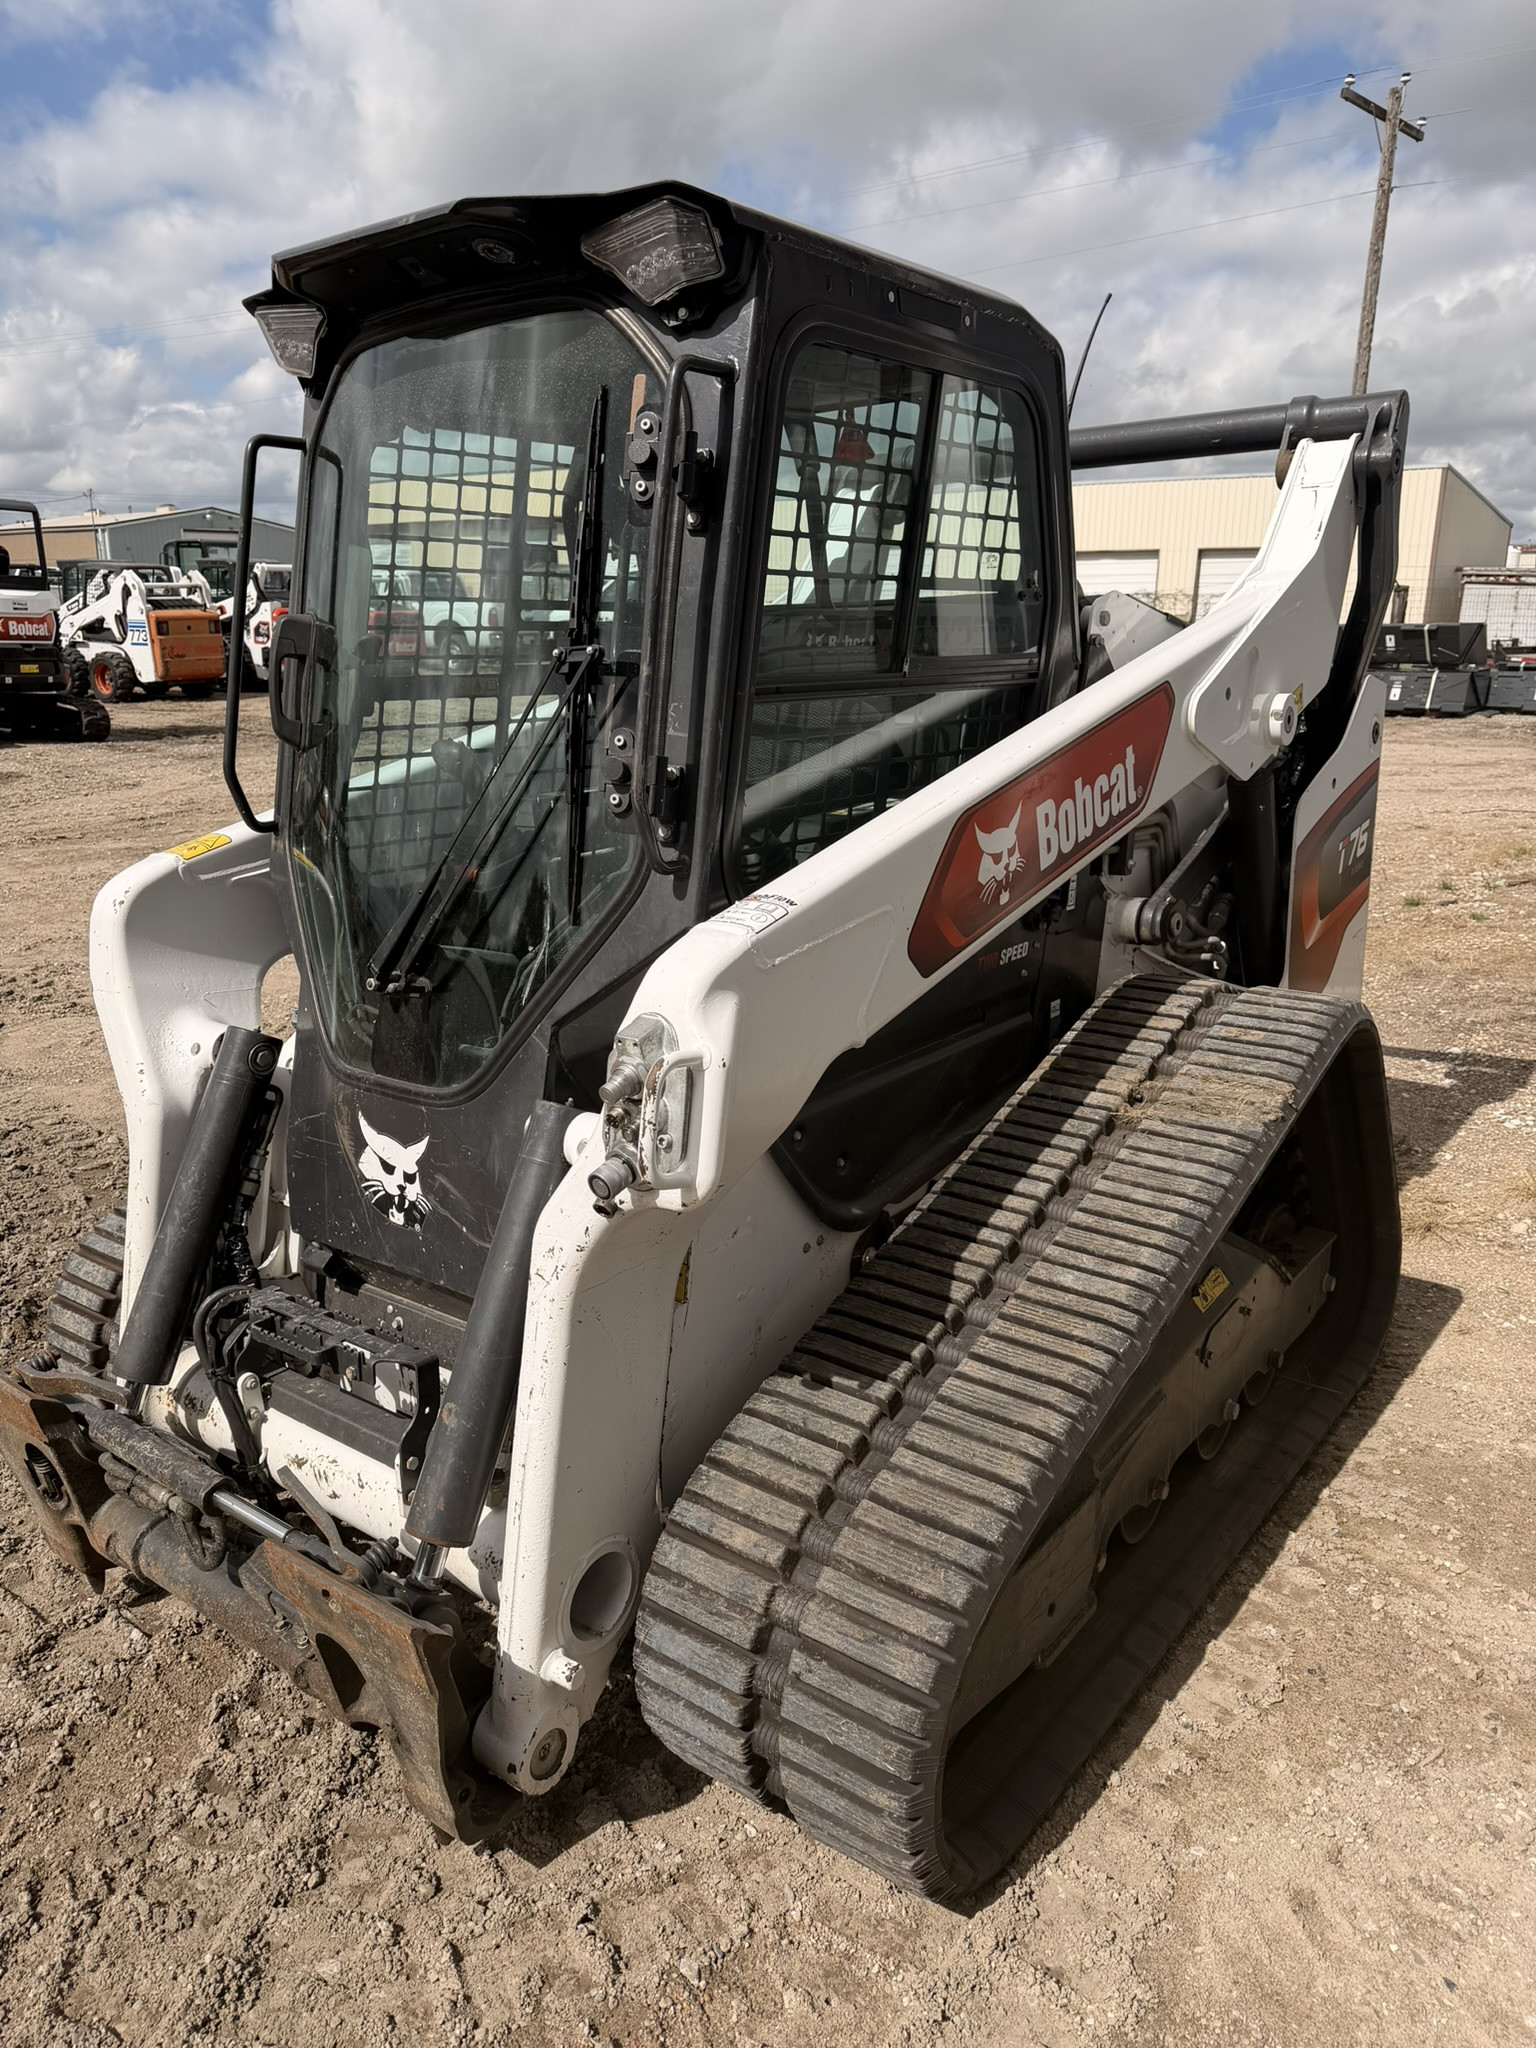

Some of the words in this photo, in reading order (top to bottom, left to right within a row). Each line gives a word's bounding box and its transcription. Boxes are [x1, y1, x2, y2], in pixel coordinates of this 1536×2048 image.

[8, 620, 49, 637] Bobcat
[129, 629, 148, 642] 773
[1036, 744, 1137, 872] Bobcat
[1338, 818, 1370, 875] T76
[1000, 941, 1029, 966] SPEED
